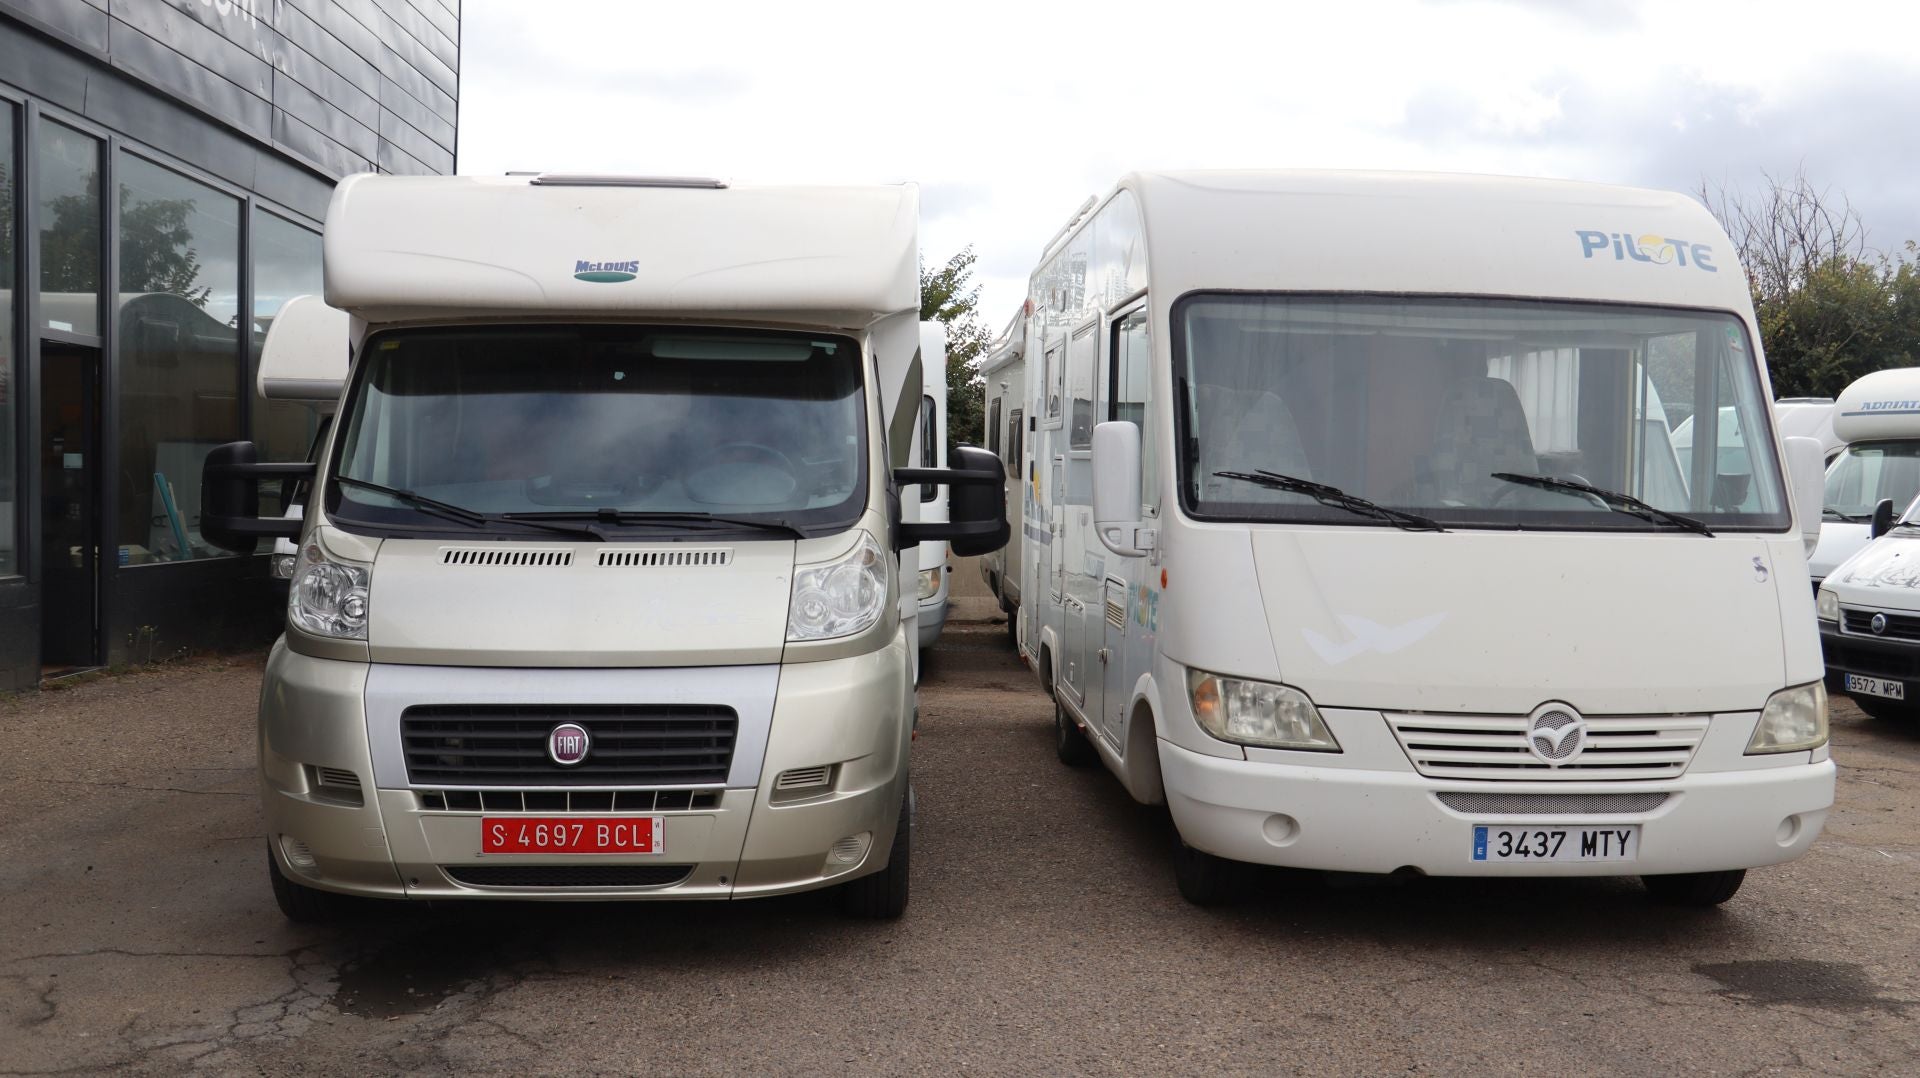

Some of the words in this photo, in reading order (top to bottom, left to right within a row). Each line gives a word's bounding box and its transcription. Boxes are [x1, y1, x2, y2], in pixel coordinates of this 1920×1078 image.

[1861, 400, 1920, 410] ADRIAT
[1850, 676, 1876, 694] 9572
[1882, 681, 1903, 698] MPM
[557, 736, 580, 754] FIAT
[491, 824, 505, 847] S
[517, 824, 584, 847] 4697
[597, 824, 645, 847] BCL
[1497, 831, 1567, 857] 3437
[1581, 830, 1631, 857] MTY
